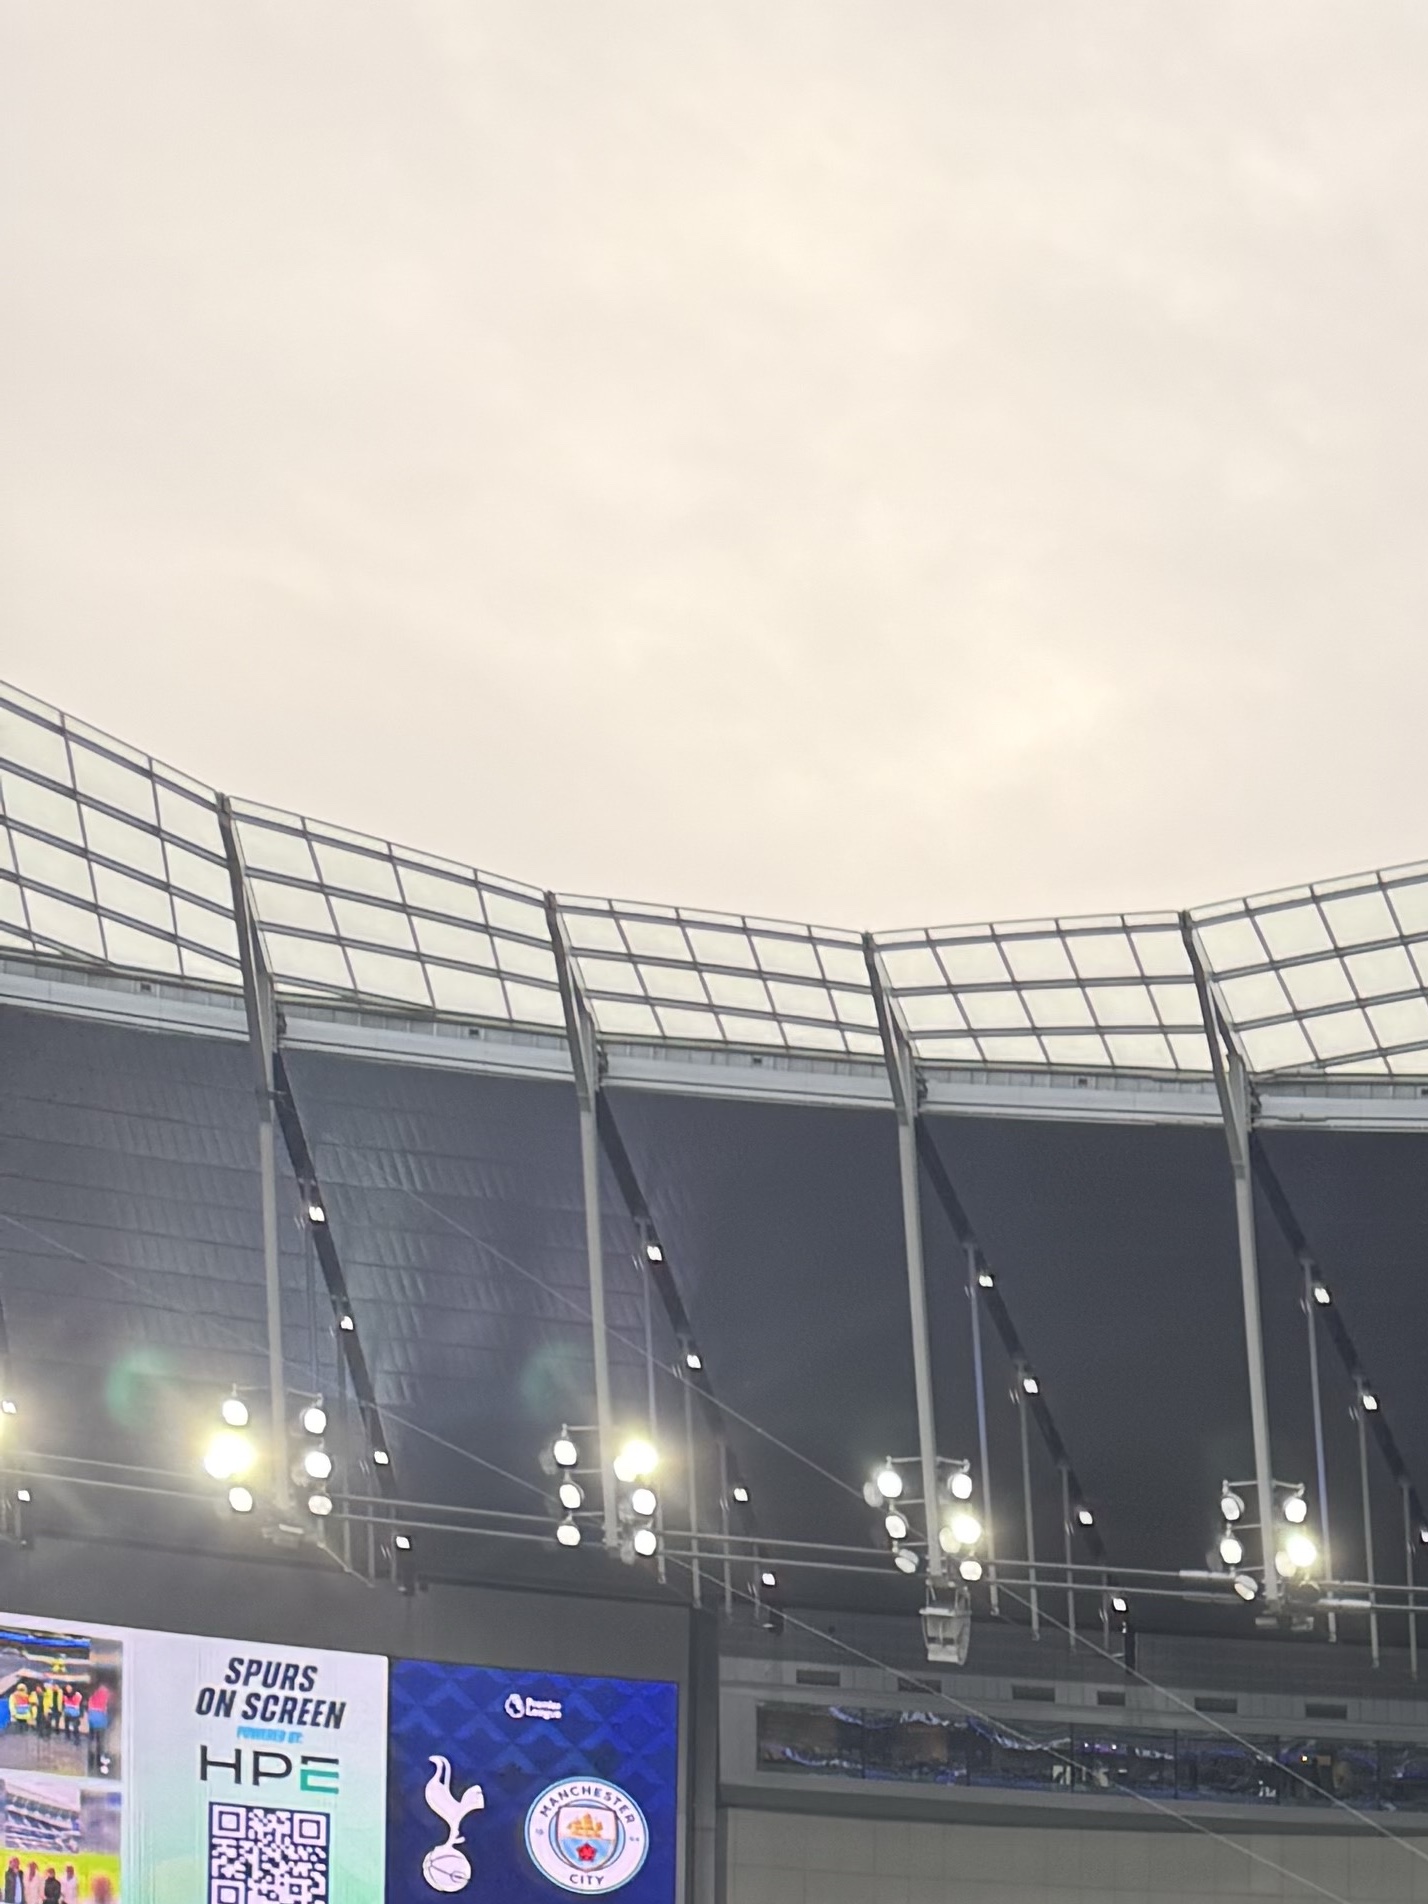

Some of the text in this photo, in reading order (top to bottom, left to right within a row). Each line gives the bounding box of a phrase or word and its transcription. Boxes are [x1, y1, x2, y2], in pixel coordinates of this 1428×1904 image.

[224, 1656, 319, 1693] SPURS
[195, 1686, 347, 1730] ON SCREEN
[199, 1744, 340, 1795] HPE
[539, 1785, 637, 1825] MANCHESTER
[569, 1873, 605, 1886] CITY
